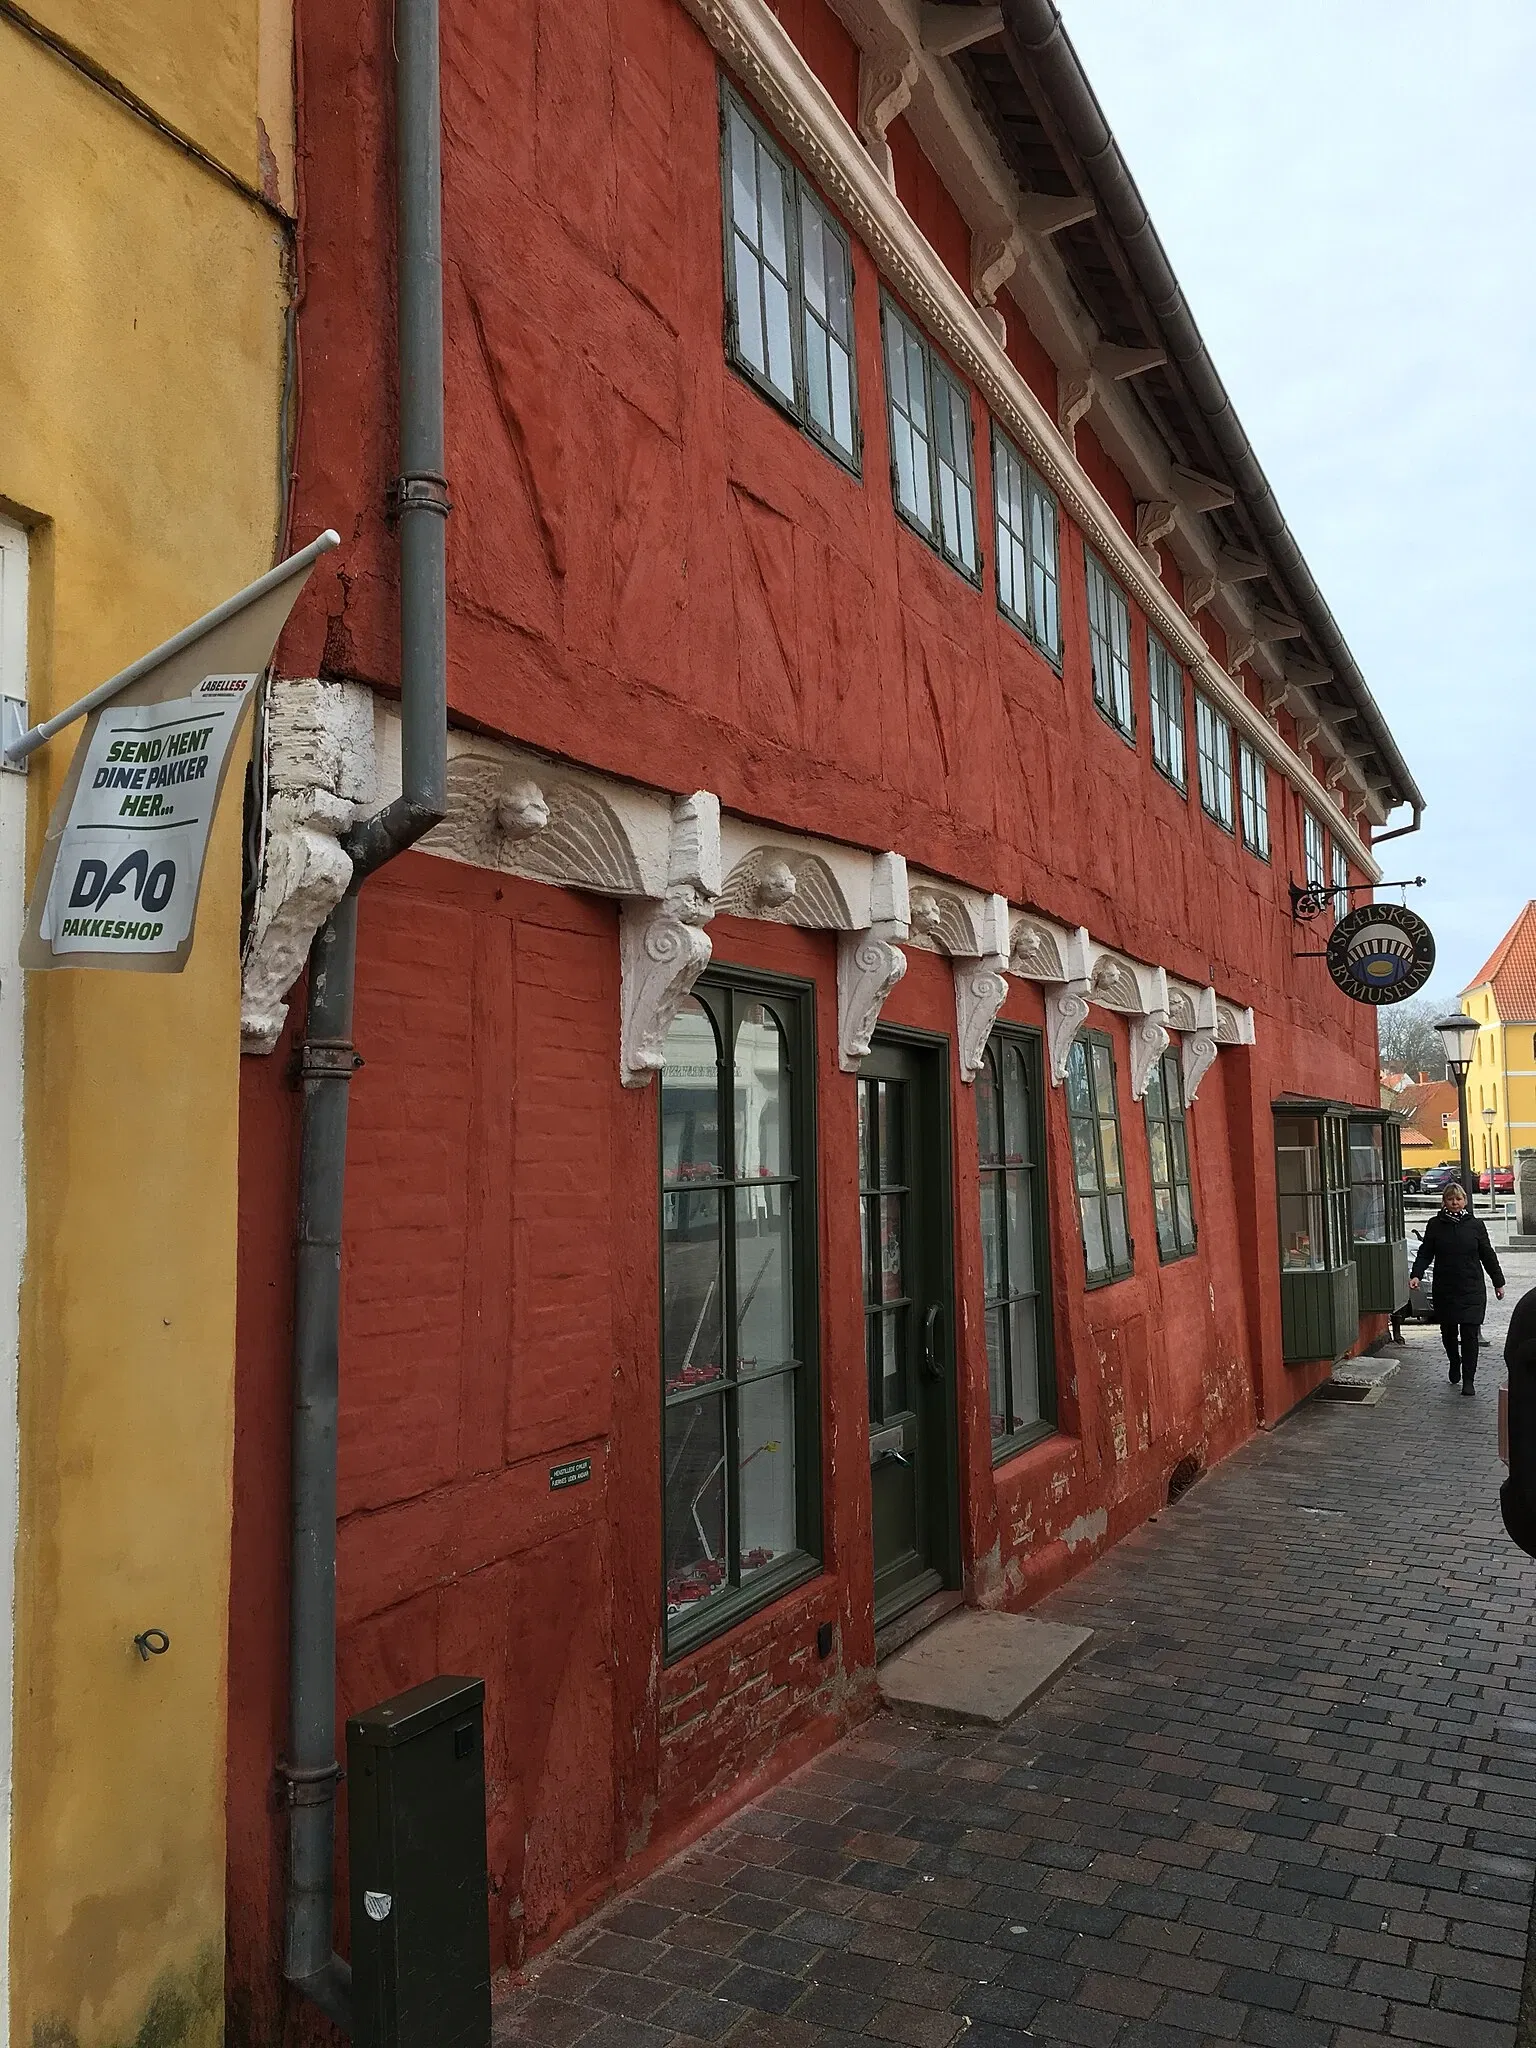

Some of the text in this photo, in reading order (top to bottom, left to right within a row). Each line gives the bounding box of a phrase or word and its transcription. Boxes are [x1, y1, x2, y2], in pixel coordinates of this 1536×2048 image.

[199, 679, 248, 692] LABELLESS
[106, 727, 214, 763] SEND/HENT
[92, 755, 209, 790] DINE PAKKER
[118, 794, 174, 817] HER...
[68, 849, 176, 913] DAO
[61, 918, 163, 941] PAKKESHOP
[1333, 905, 1428, 947] SKÆLSKØR
[1331, 960, 1433, 1002] BYMUSEUM
